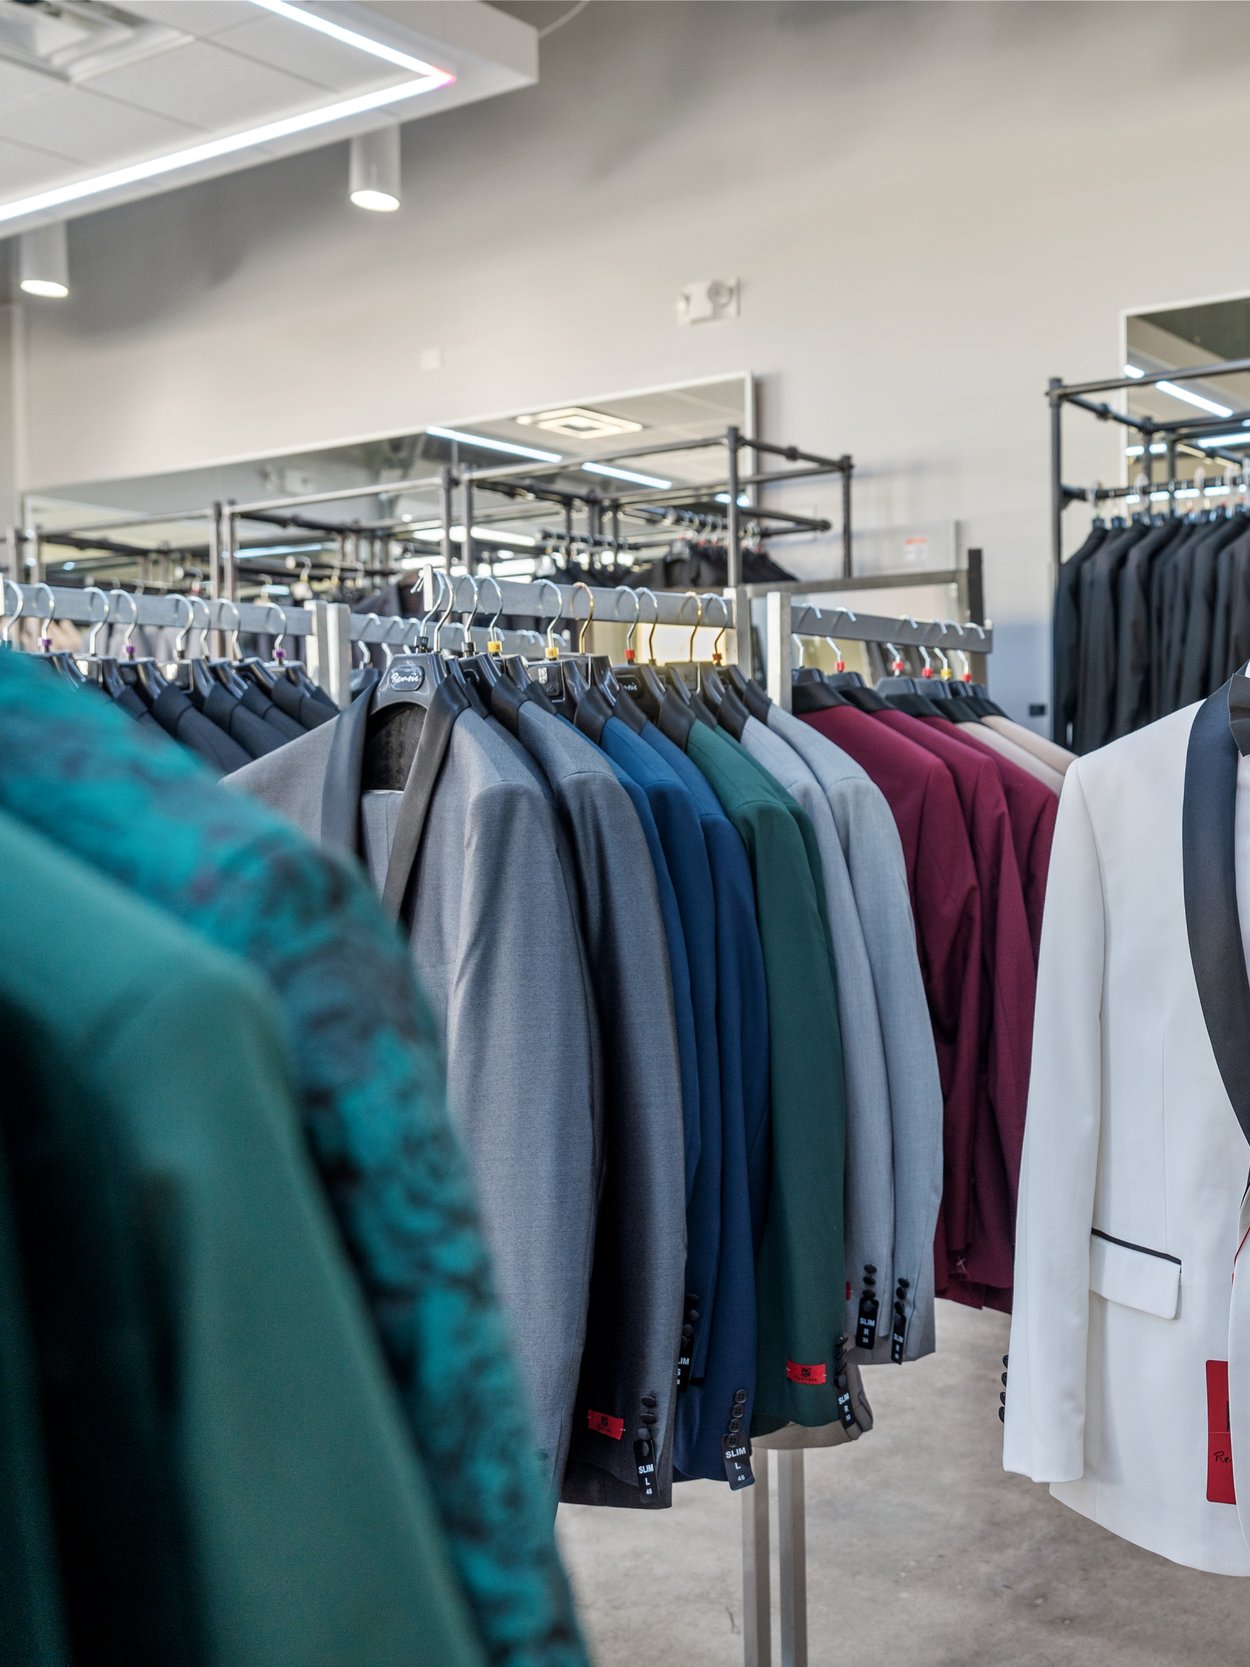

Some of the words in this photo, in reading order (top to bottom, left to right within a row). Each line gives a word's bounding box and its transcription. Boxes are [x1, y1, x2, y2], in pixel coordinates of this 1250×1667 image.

[860, 1317, 876, 1327] SLIM
[726, 1447, 747, 1459] SLIM
[638, 1463, 654, 1474] SLIM
[735, 1462, 741, 1470] L
[645, 1477, 650, 1486] L
